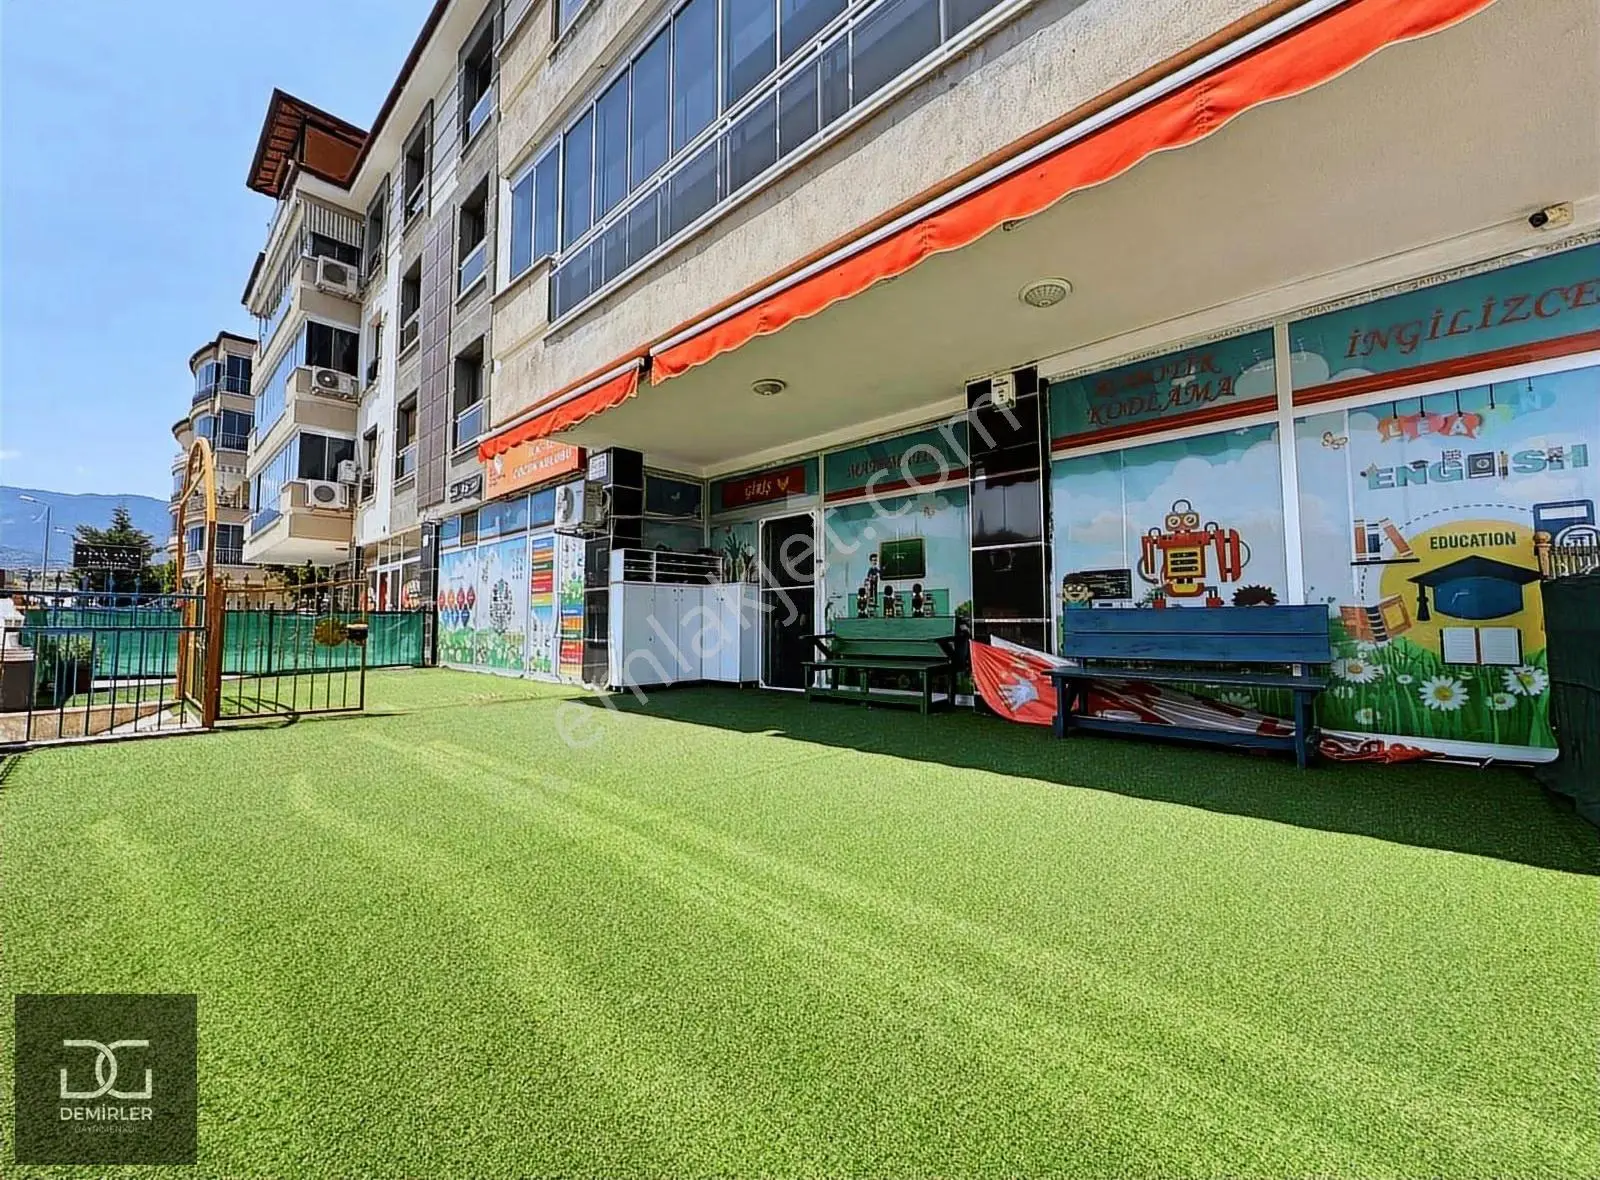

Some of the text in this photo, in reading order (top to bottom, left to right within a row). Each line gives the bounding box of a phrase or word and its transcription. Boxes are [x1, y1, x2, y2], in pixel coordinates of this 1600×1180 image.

[1343, 277, 1600, 359] İNGİLİZCE
[1086, 375, 1236, 426] KODLAMA
[1366, 443, 1589, 490] ENGISH
[1429, 531, 1517, 550] EDUCATION
